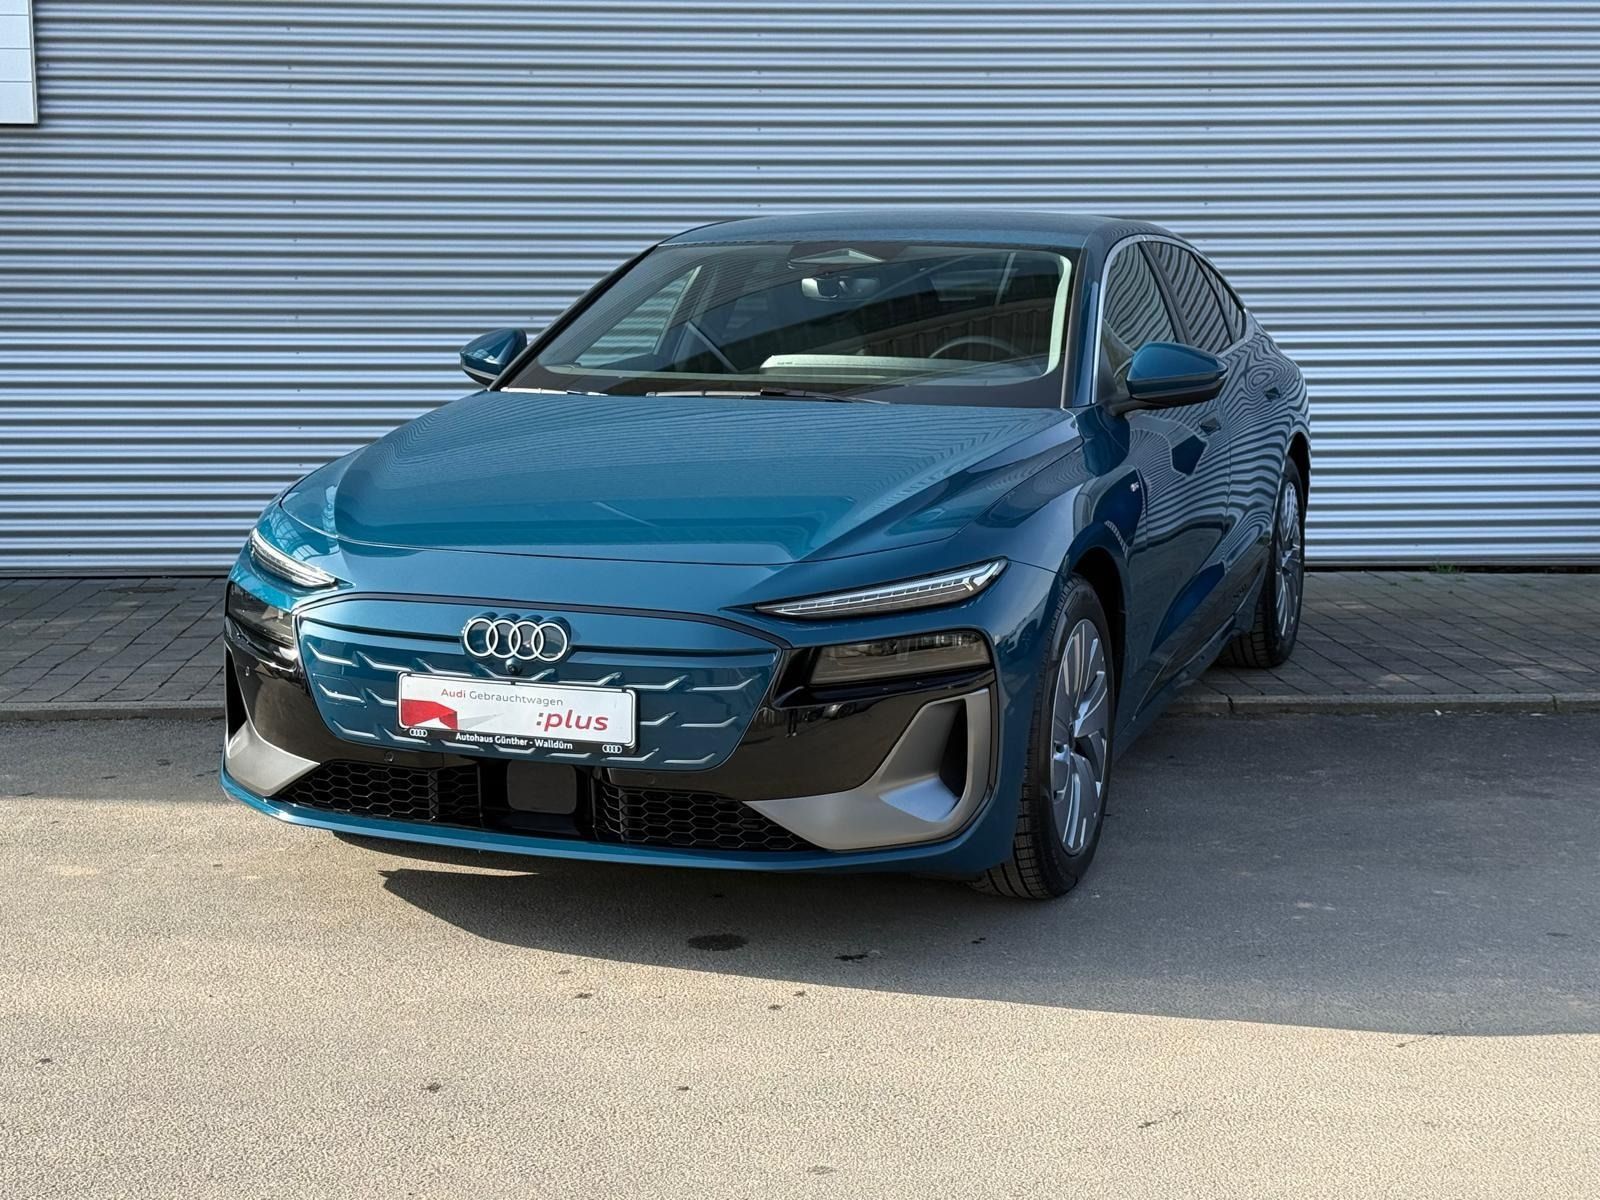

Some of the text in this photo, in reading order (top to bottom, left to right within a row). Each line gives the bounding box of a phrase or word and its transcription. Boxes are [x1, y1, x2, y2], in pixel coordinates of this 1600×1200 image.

[441, 688, 564, 707] Audi Gebrauchtwagen
[536, 709, 609, 732] :plus
[455, 732, 493, 743] Autohaus
[494, 735, 528, 746] Günther
[534, 738, 573, 750] Walldürn
